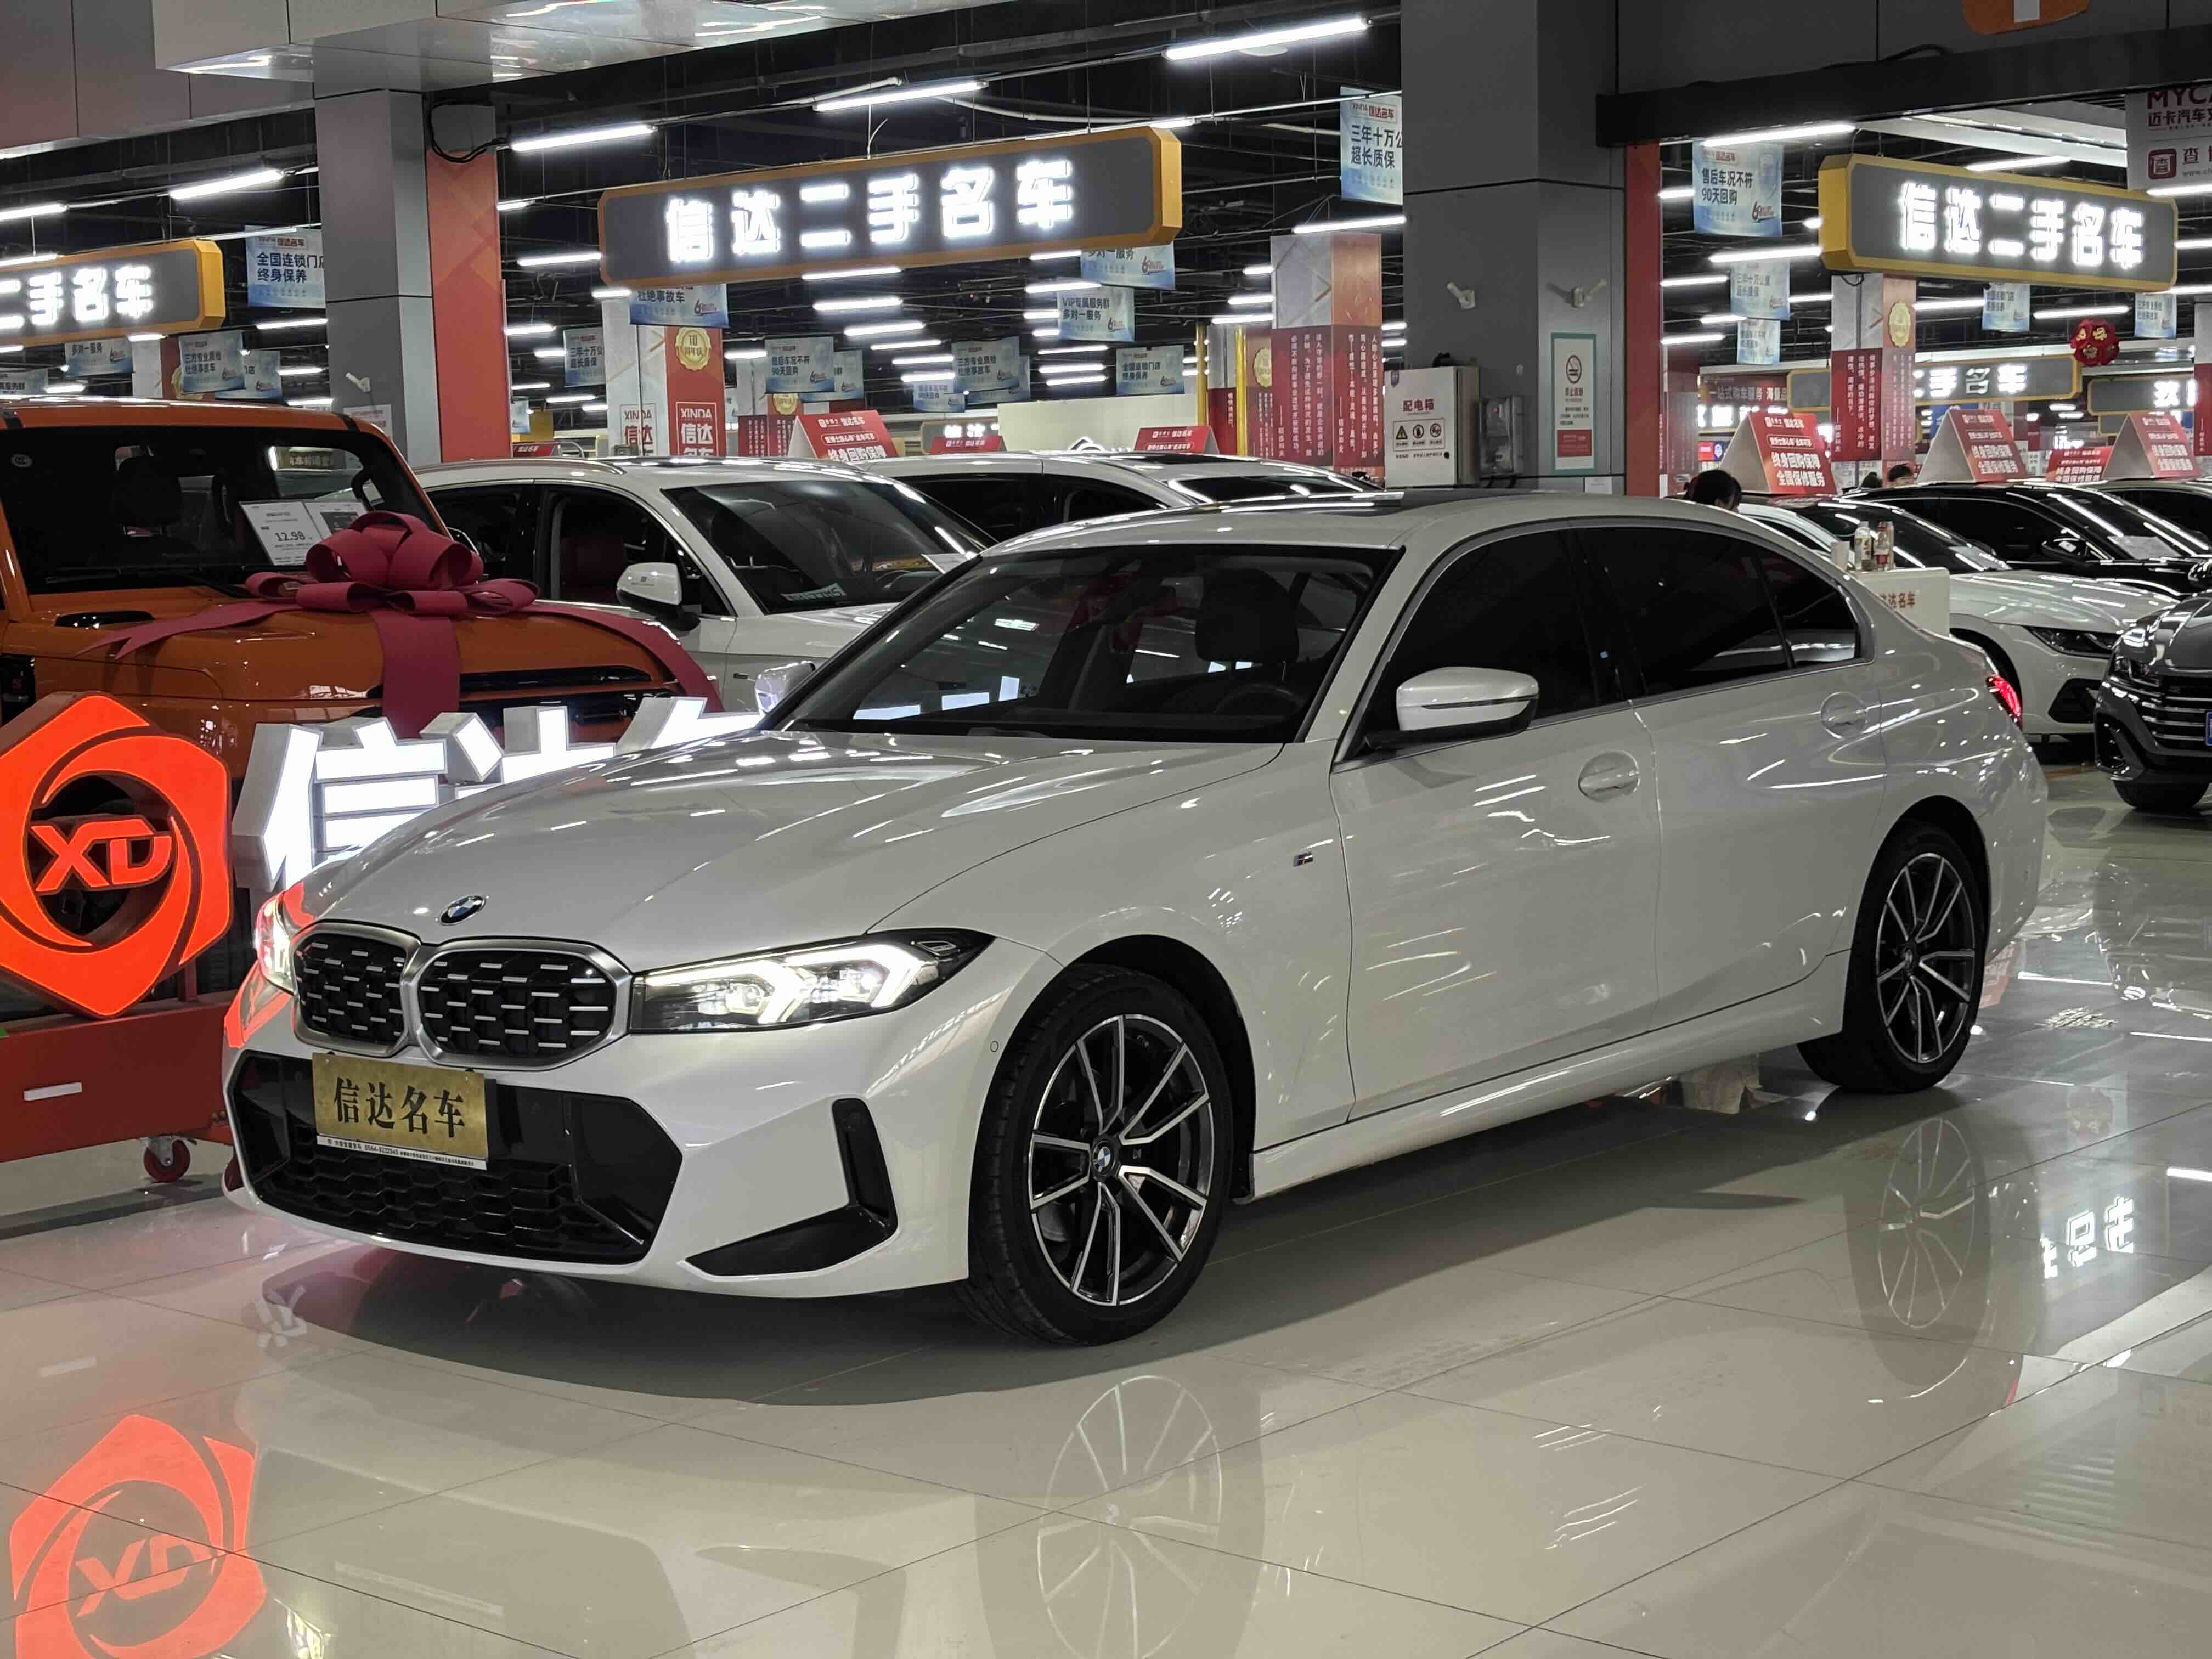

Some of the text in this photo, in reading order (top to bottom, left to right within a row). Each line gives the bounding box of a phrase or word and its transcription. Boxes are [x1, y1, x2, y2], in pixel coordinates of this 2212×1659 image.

[2147, 88, 2212, 109] MYC
[2148, 108, 2212, 127] 迈卡汽车
[1351, 146, 1395, 168] 超长质保
[1702, 167, 1753, 188] 售后车况不符
[1702, 188, 1737, 205] 90天回购
[665, 159, 1072, 262] 信达二手名车
[1901, 181, 2145, 269] 信达二手名车
[257, 268, 307, 283] 终身保养
[1063, 309, 1102, 321] 多对一服务
[1914, 363, 2028, 398] 手名车
[681, 408, 712, 419] XINDA
[1403, 399, 1435, 412] 配电箱
[681, 422, 714, 445] 信达
[275, 531, 306, 541] 12.98
[29, 816, 174, 896] XD
[333, 1076, 466, 1138] 信达名车
